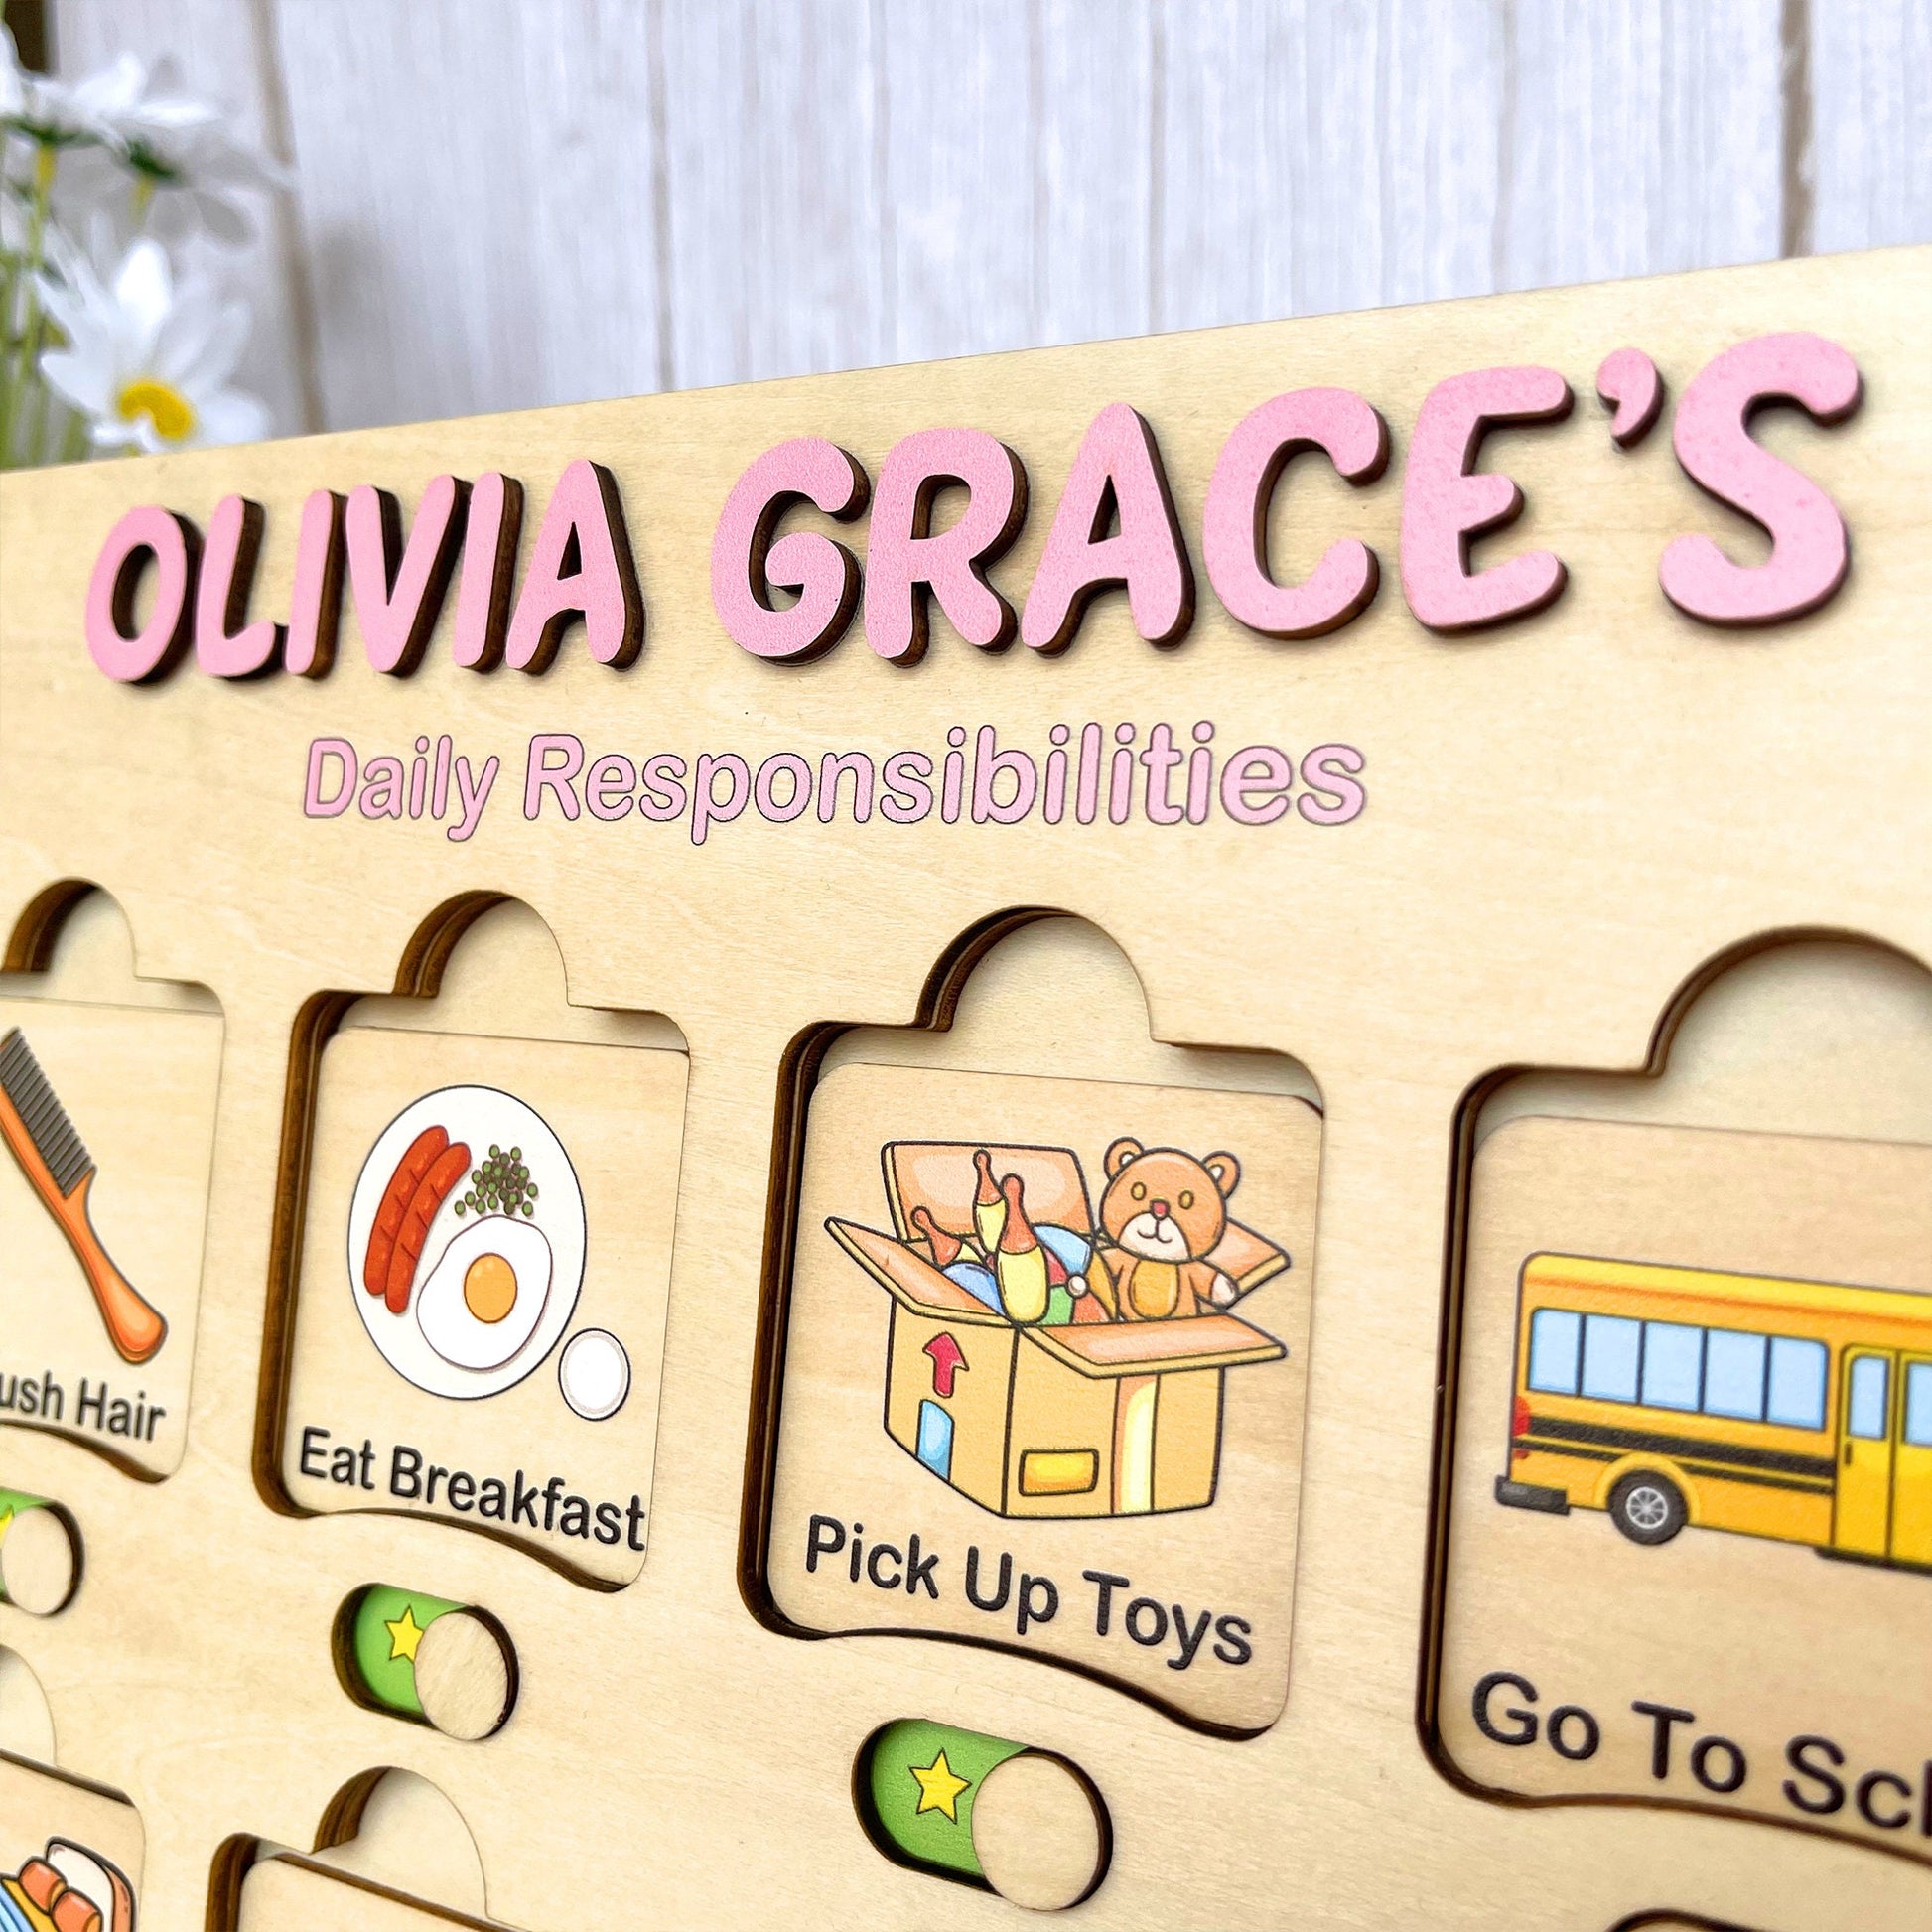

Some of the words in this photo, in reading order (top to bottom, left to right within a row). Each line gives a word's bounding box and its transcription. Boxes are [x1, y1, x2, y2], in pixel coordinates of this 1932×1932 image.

[85, 459, 643, 683] OLIVIA
[710, 330, 1863, 664] GRACE'S
[303, 734, 500, 843] Daily
[523, 720, 1367, 846] Responsibilities
[75, 1376, 167, 1443] Hair
[300, 1426, 375, 1490] Eat
[390, 1446, 645, 1552] Breakfast
[806, 1514, 939, 1599] Pick
[965, 1546, 1058, 1634] Up
[1082, 1570, 1252, 1670] Toys
[1472, 1671, 1601, 1761] Go
[1630, 1701, 1747, 1793] To
[1783, 1734, 1932, 1837] Sc
